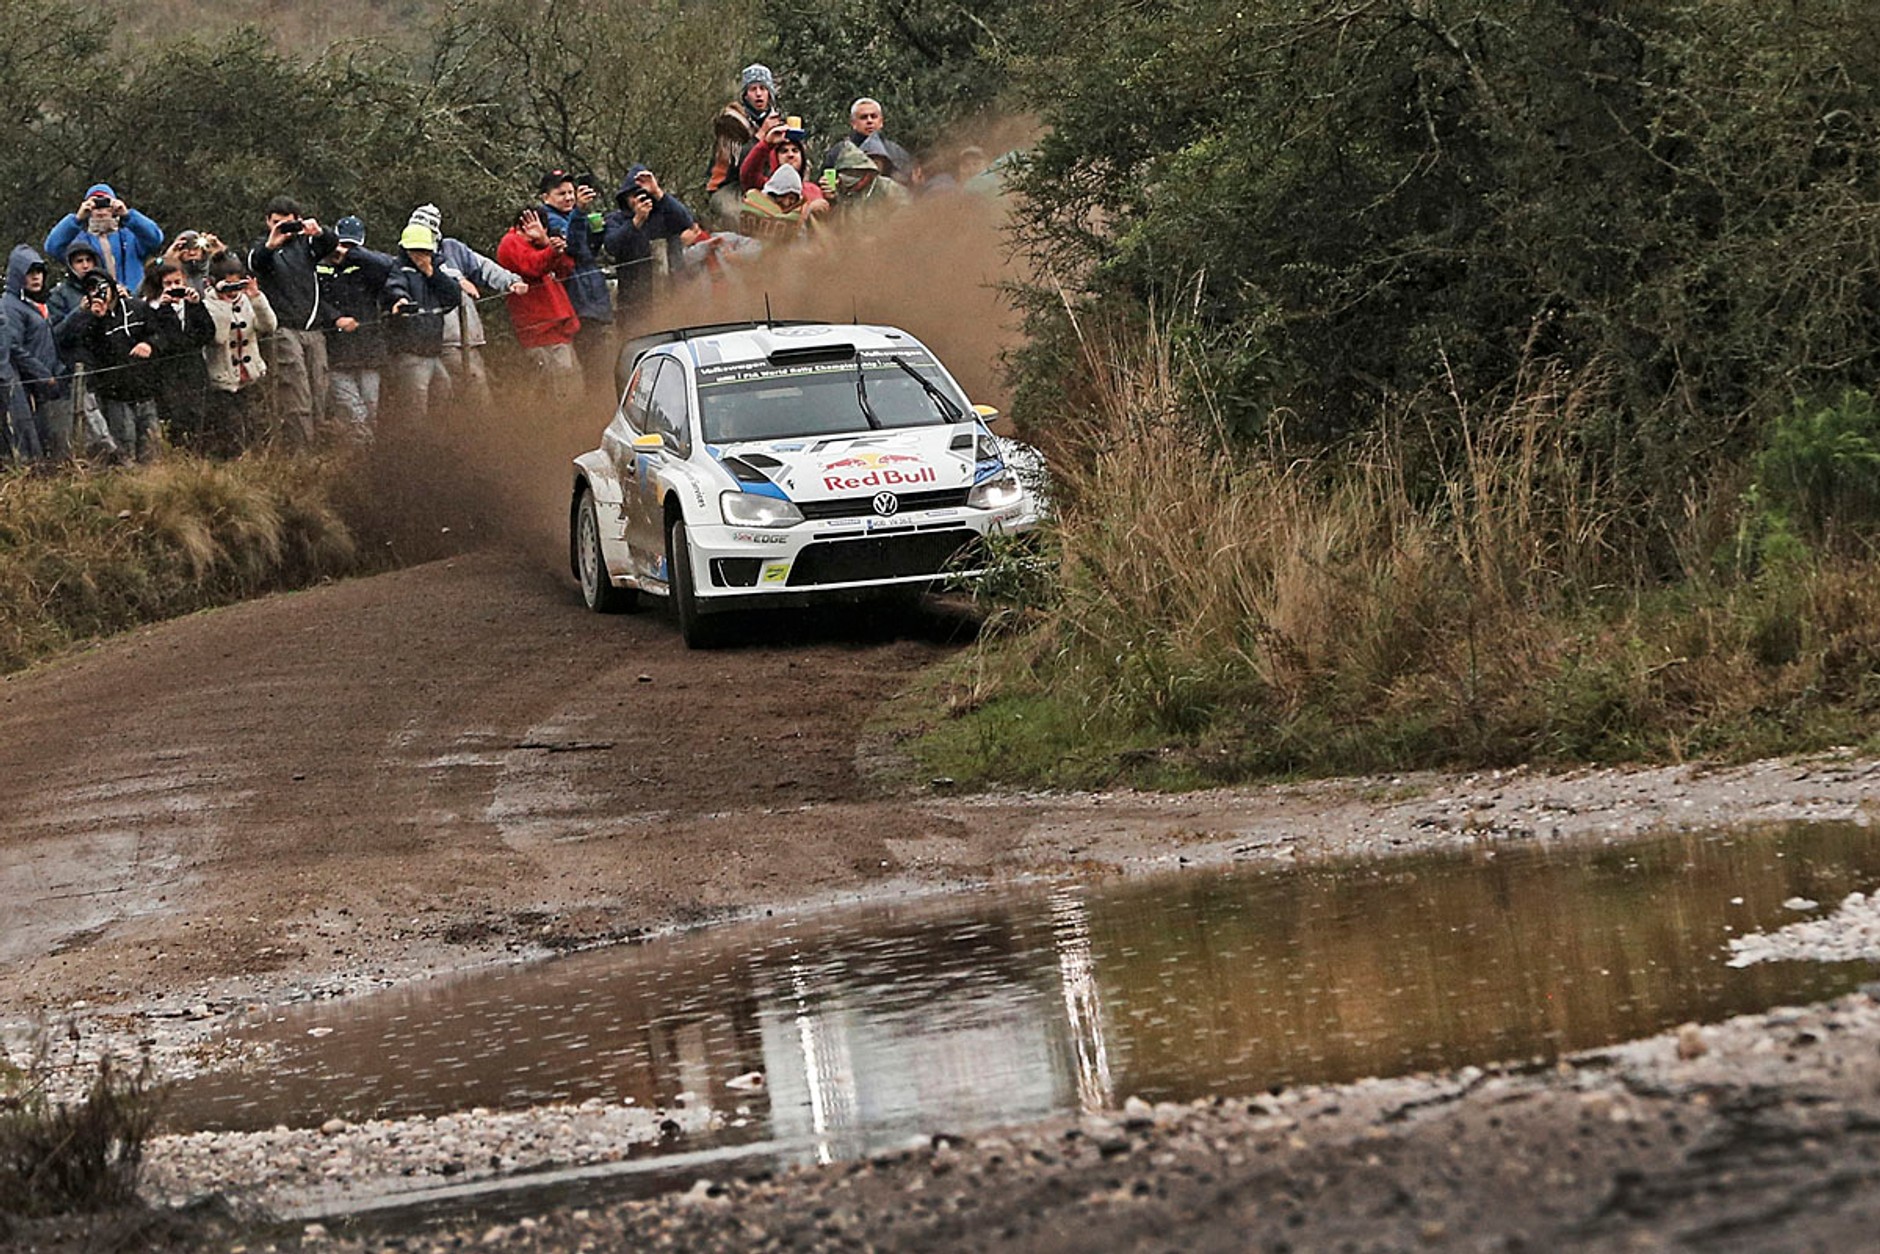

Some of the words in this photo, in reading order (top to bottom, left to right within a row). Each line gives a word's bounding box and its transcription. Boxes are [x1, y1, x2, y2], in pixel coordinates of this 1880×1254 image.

[700, 362, 767, 375] Volkswagen
[760, 368, 788, 377] World
[823, 471, 880, 491] Red
[882, 467, 936, 485] Bull
[753, 534, 789, 543] EDGE
